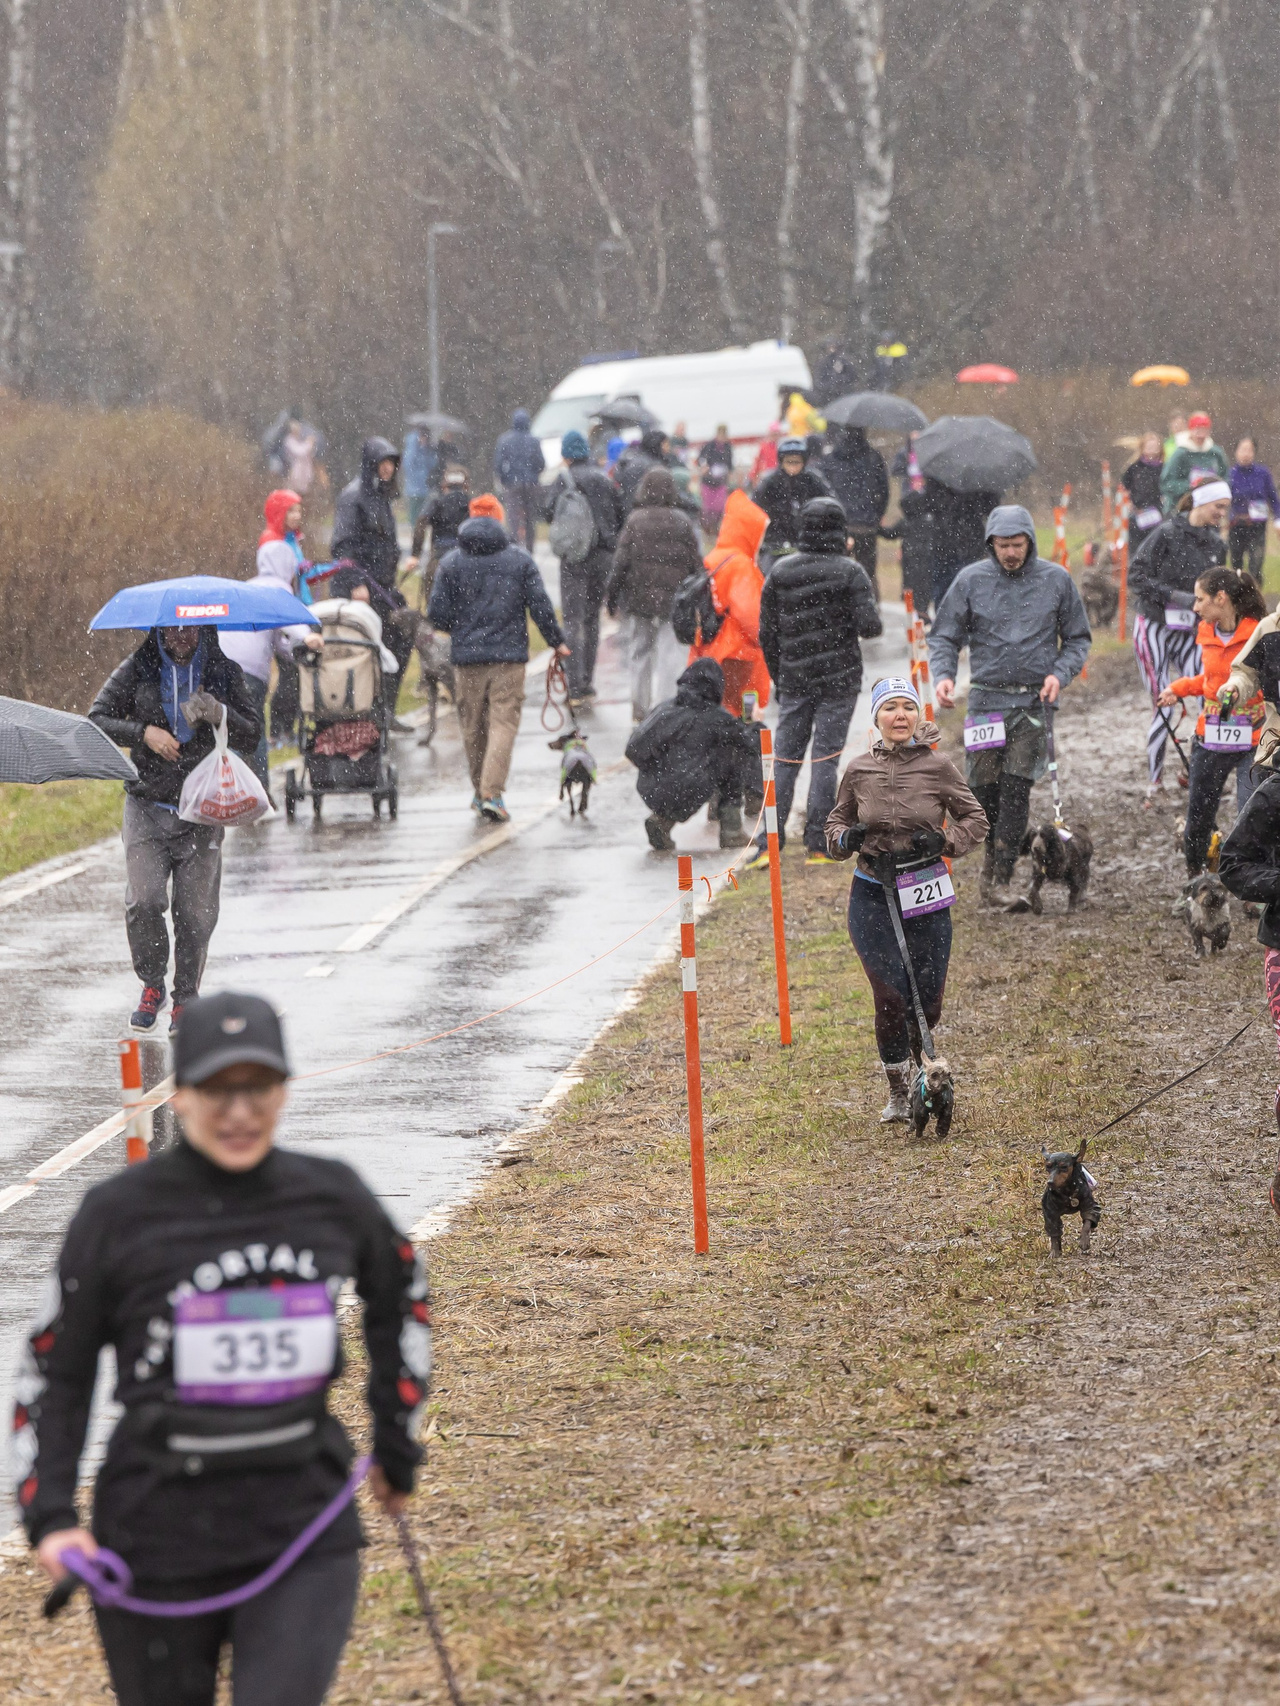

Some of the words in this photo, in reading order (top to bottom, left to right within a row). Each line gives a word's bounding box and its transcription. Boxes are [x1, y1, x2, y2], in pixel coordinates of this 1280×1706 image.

[178, 605, 225, 617] TEBOIL
[972, 727, 994, 742] 207
[1216, 728, 1242, 742] 179
[913, 880, 943, 904] 221
[212, 1329, 302, 1374] 335
